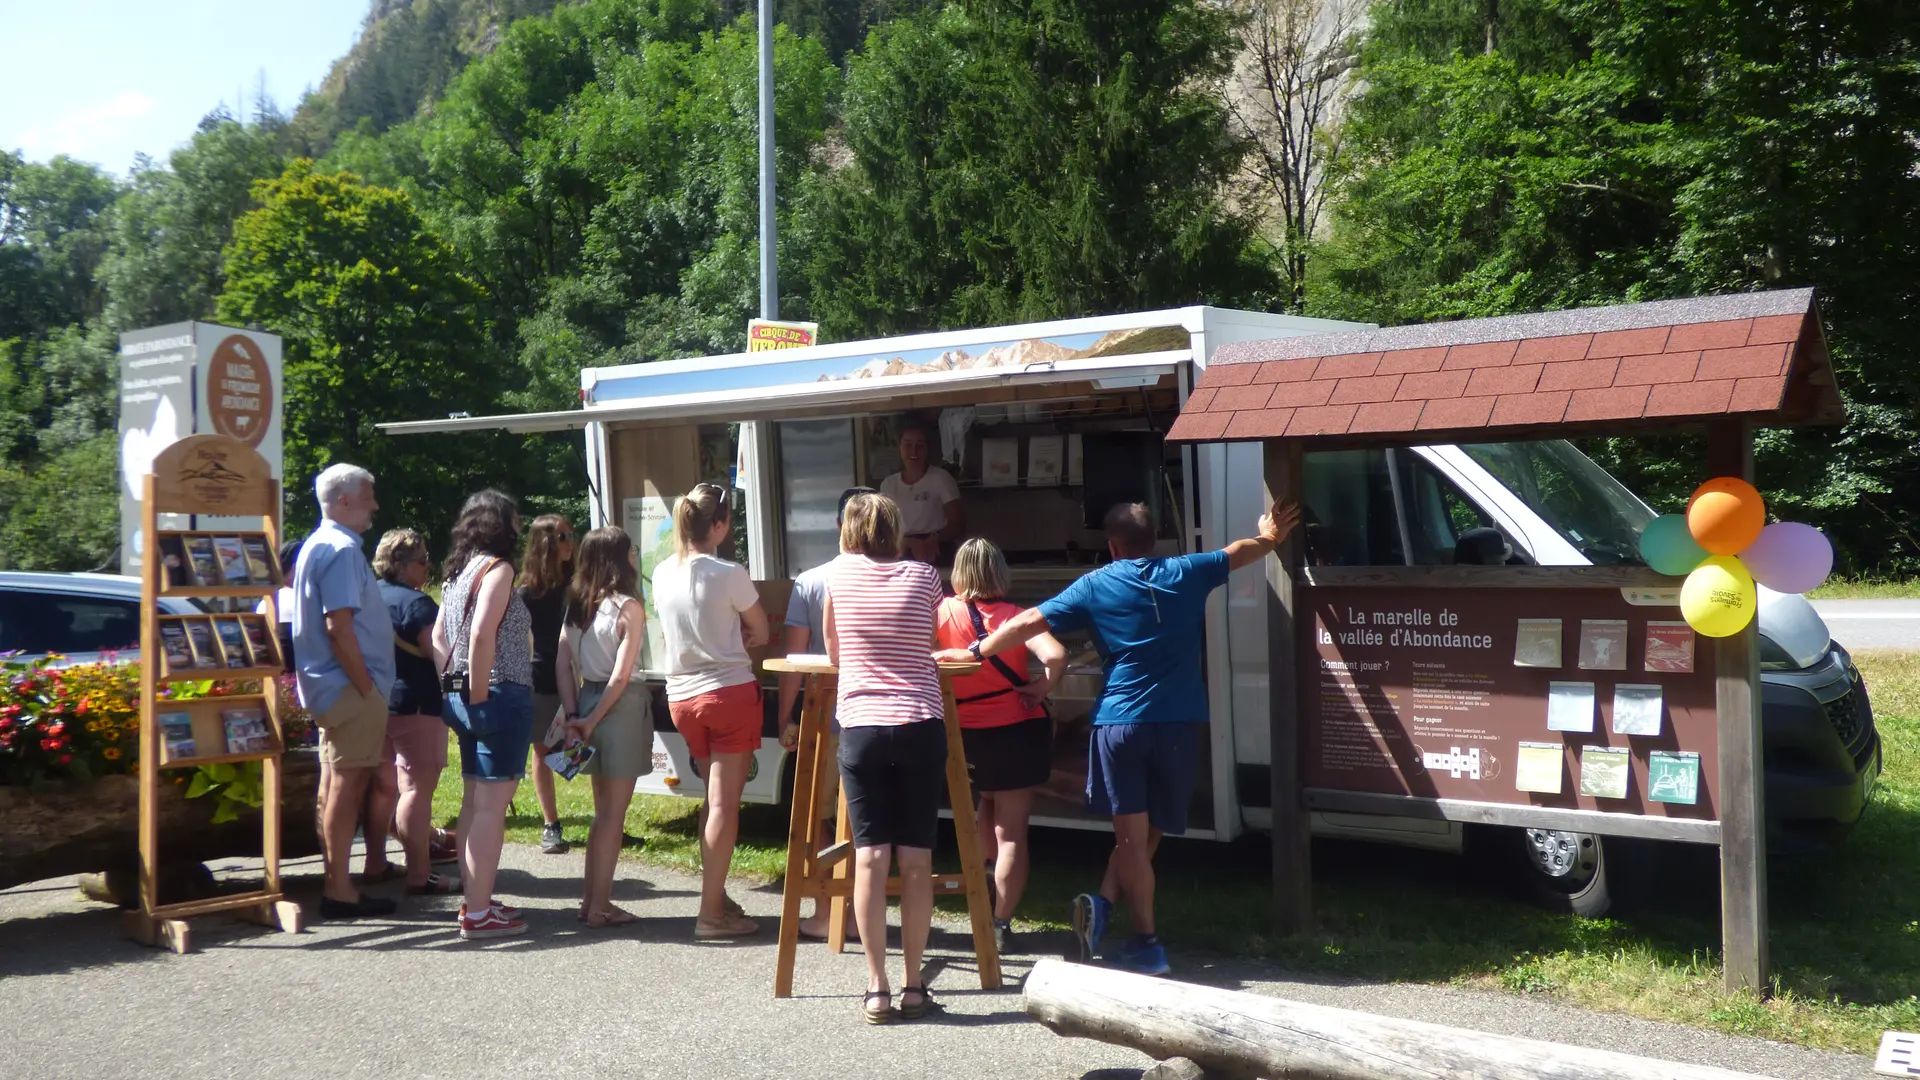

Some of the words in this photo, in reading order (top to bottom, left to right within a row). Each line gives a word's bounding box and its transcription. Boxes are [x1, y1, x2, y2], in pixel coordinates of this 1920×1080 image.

[759, 328, 787, 339] CIRQUE
[789, 331, 801, 342] DE
[752, 338, 808, 352] VERO
[1711, 591, 1736, 601] Savoie
[1348, 607, 1367, 625] La
[1373, 608, 1433, 626] marelle
[1439, 608, 1459, 626] de
[1318, 628, 1333, 645] la
[1339, 629, 1384, 646] vallée
[1390, 628, 1493, 649] d'Abondance
[1320, 659, 1358, 671] Comment
[1360, 661, 1382, 673] jouer
[1385, 661, 1391, 672] ?
[651, 753, 668, 762] ages
[652, 762, 667, 770] voie
